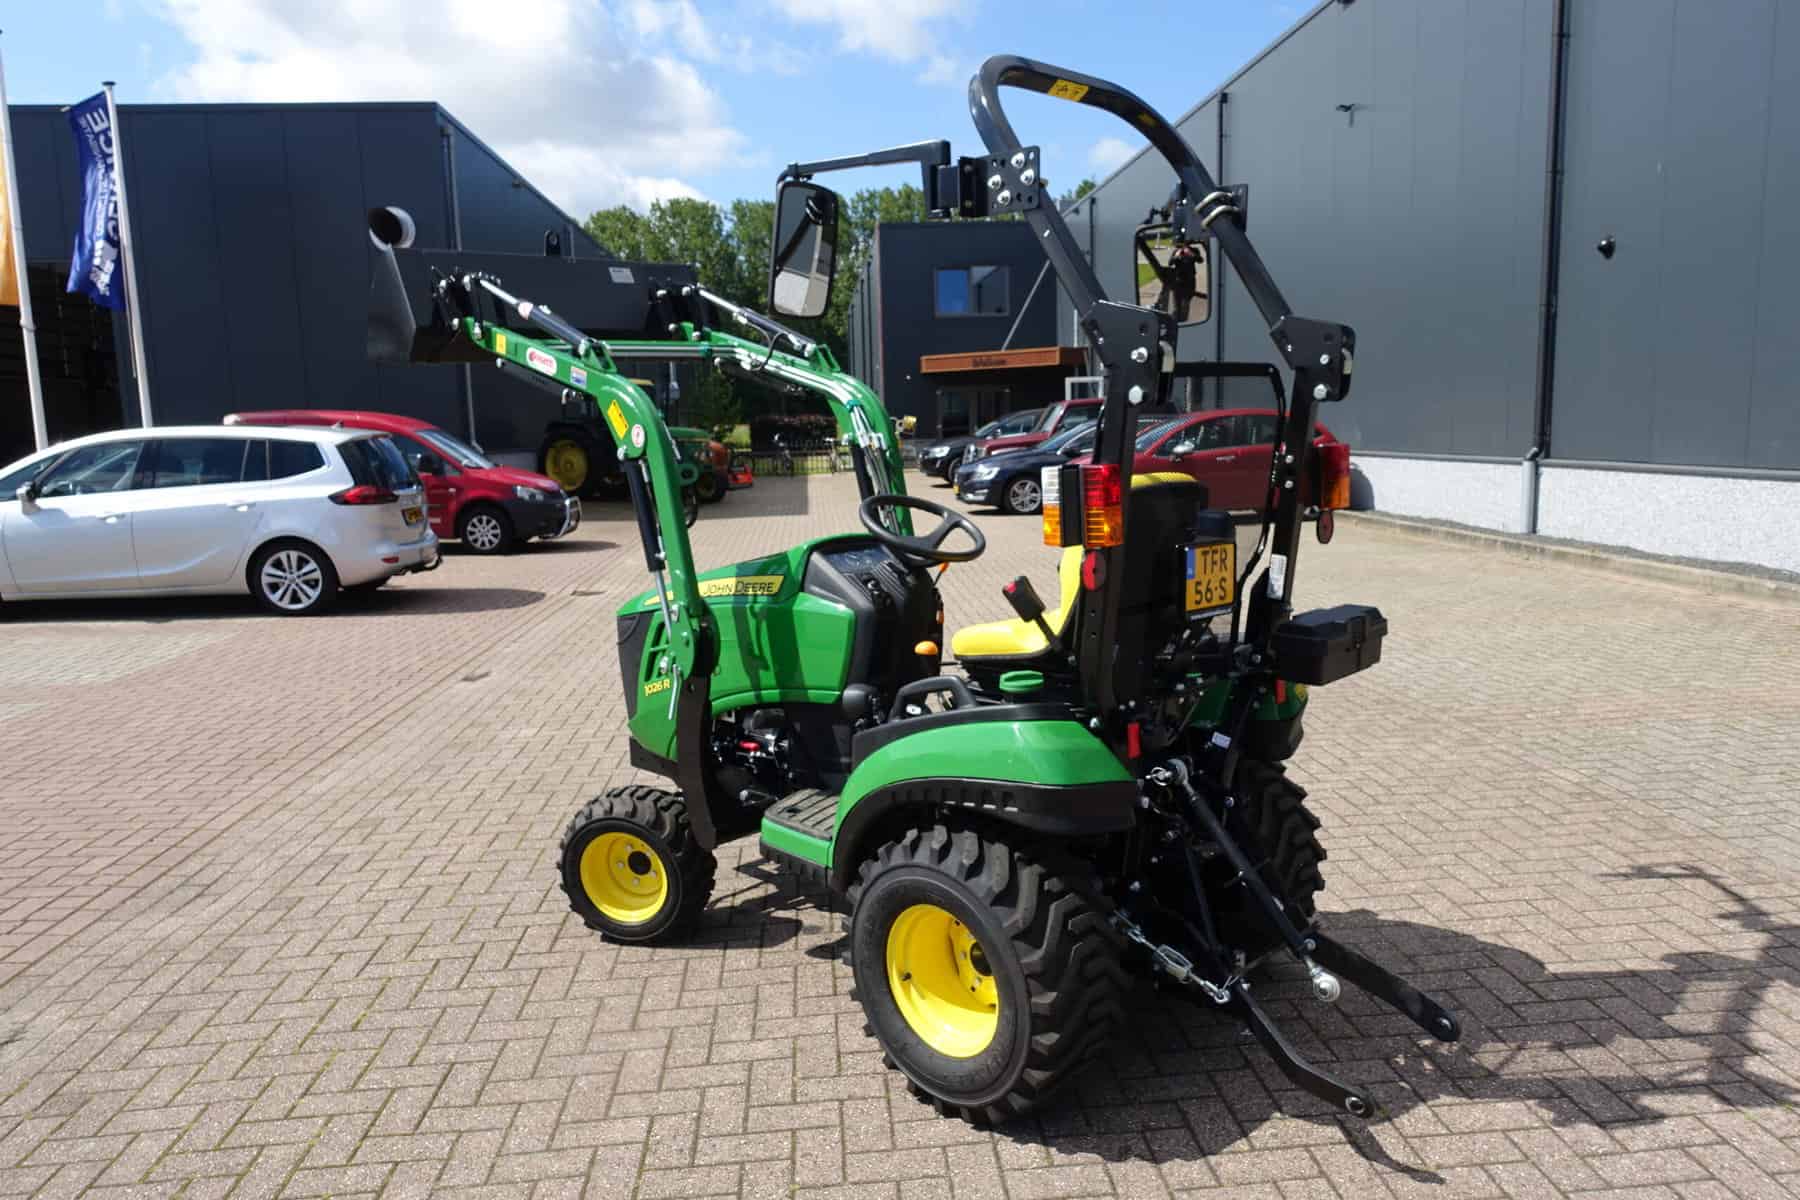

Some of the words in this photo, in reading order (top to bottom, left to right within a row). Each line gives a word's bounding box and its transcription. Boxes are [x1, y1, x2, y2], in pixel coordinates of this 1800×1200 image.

[1201, 548, 1228, 575] TFR
[703, 583, 734, 595] JOHN
[735, 581, 776, 593] DEERE
